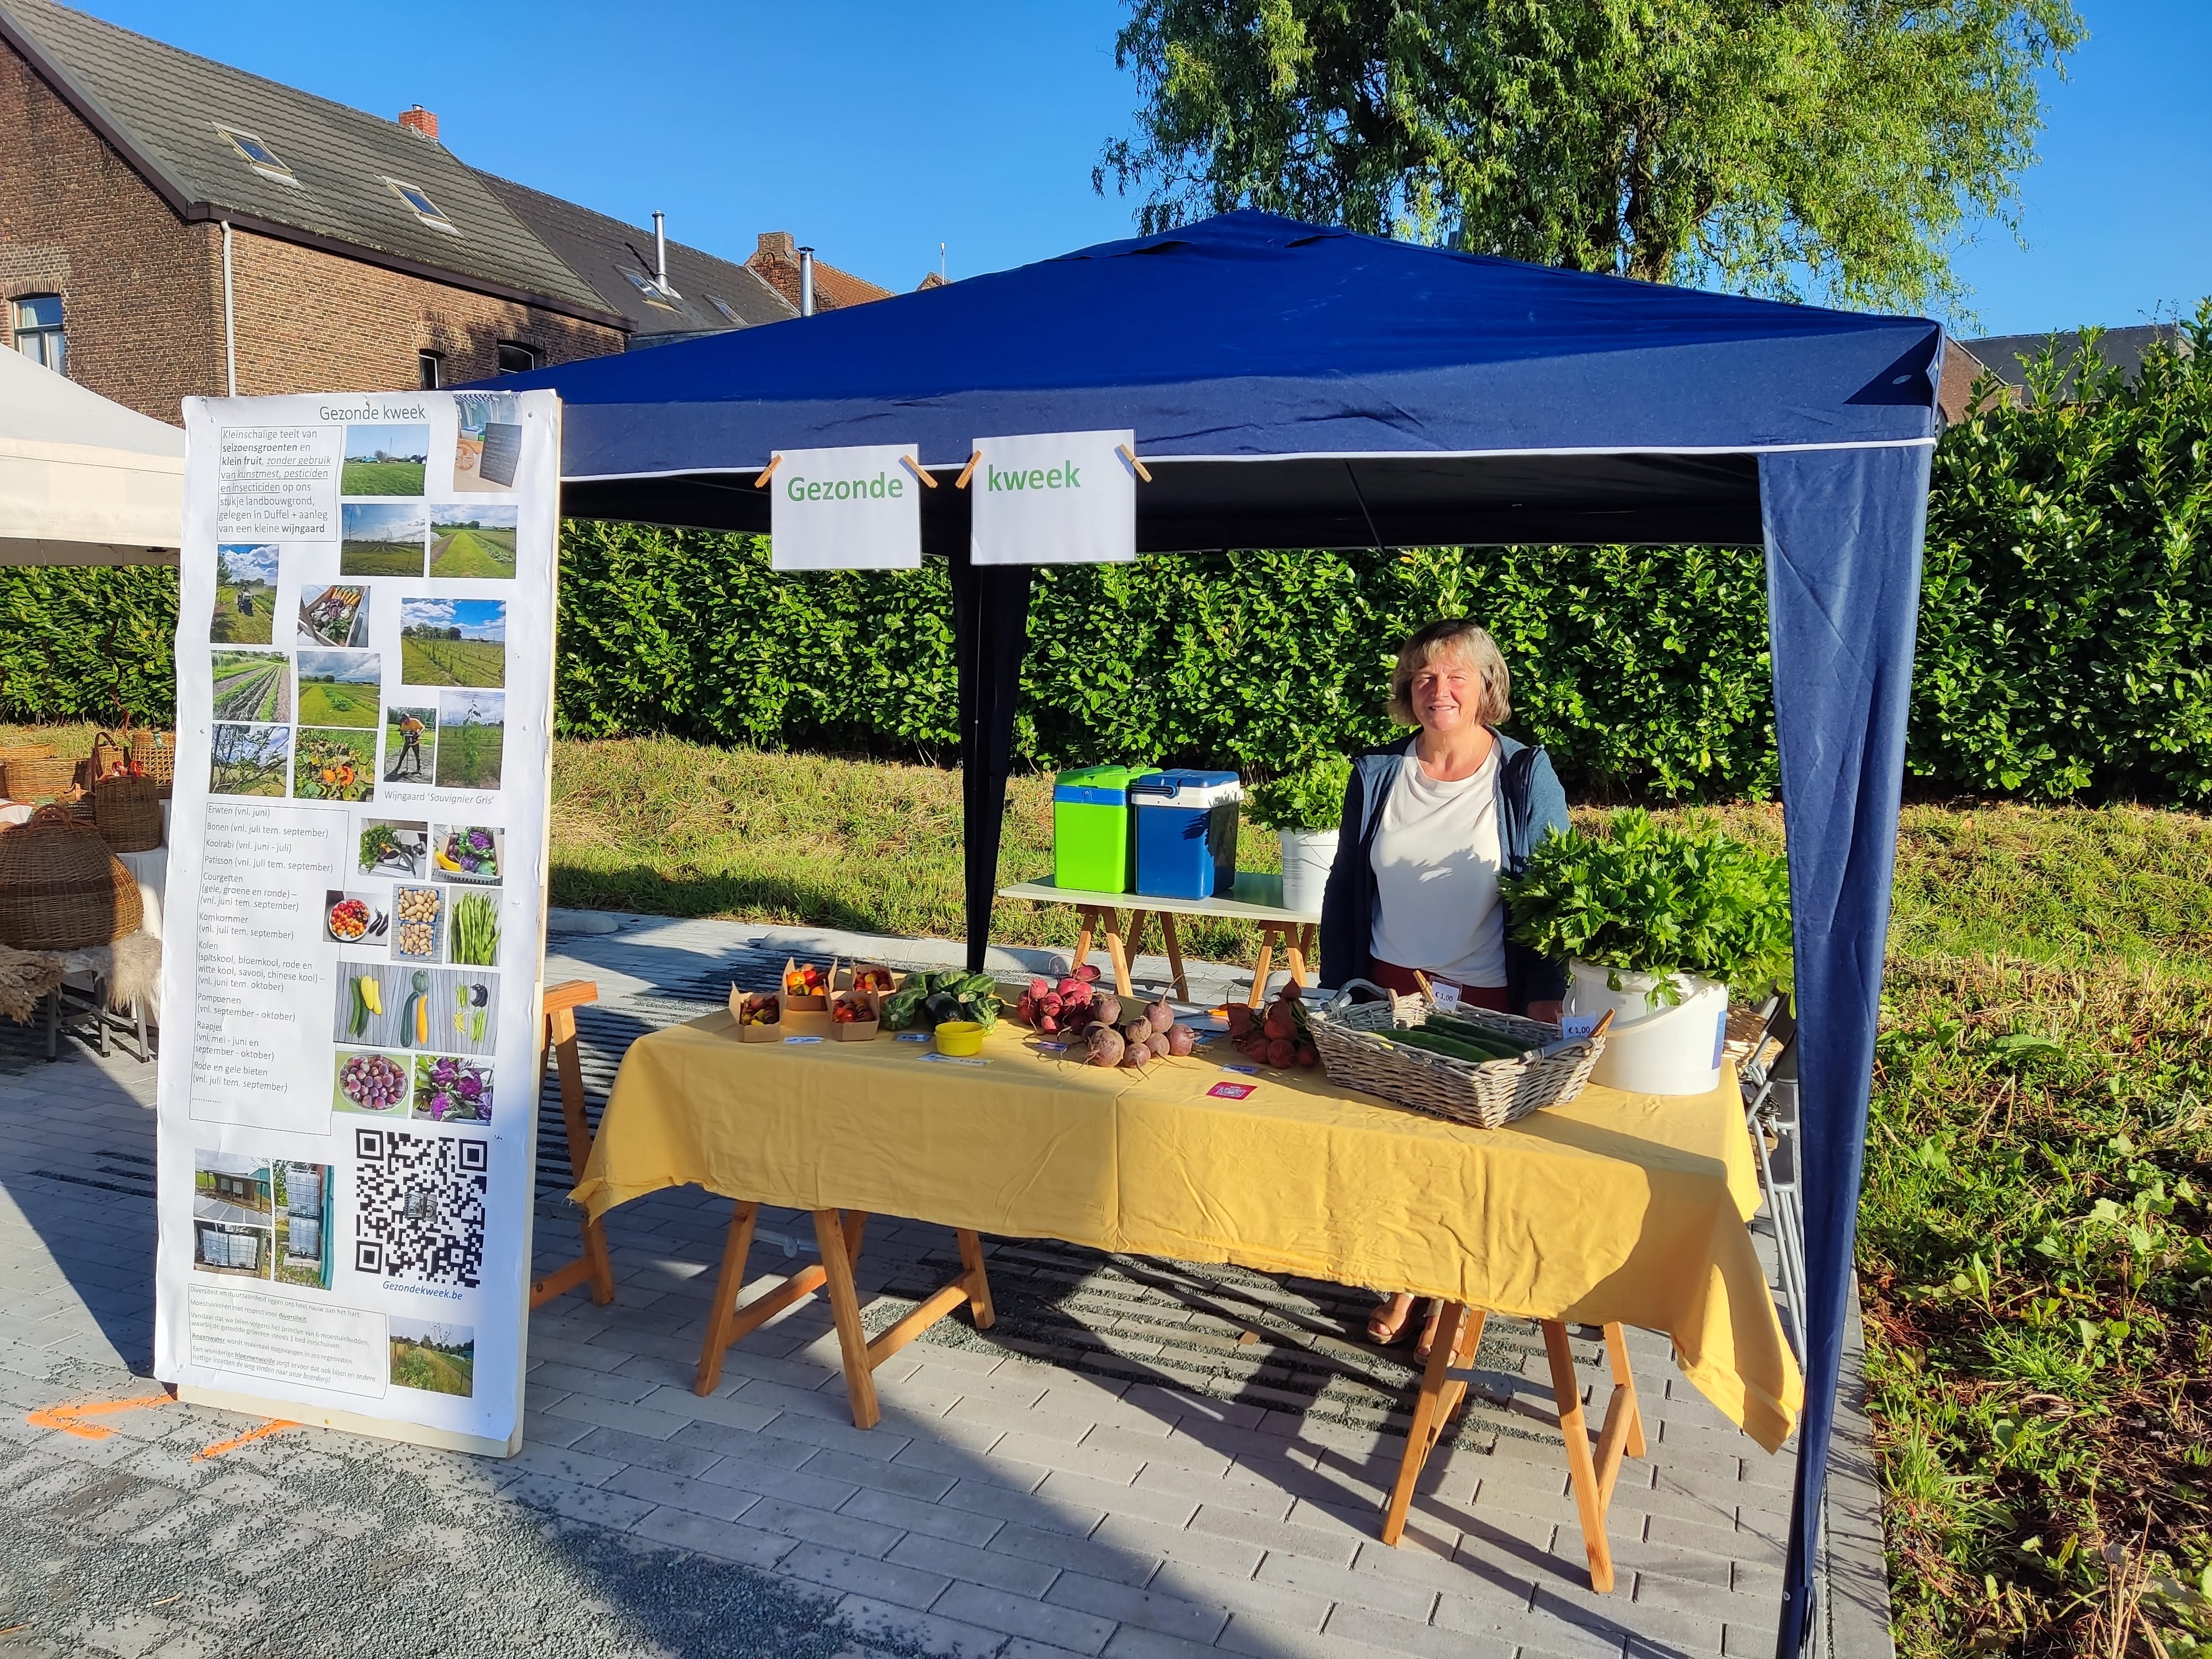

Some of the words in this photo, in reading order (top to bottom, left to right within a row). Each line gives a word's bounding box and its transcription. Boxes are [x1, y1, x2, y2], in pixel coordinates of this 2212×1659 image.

[320, 404, 379, 420] Gezonde
[383, 404, 425, 420] kweek
[223, 429, 277, 440] Kleinschalige
[280, 429, 300, 438] teelt
[222, 443, 297, 453] seizoensgroenten
[222, 456, 241, 465] klein
[244, 456, 264, 466] fruit,
[267, 456, 296, 465] zonder
[298, 456, 331, 466] gebruik
[237, 469, 281, 478] kunstmest,
[284, 469, 327, 479] pesticiden
[787, 472, 904, 502] Gezonde
[988, 460, 1080, 491] kweek
[232, 482, 280, 492] insecticiden
[283, 484, 293, 493] op
[220, 497, 243, 508] stukje
[246, 496, 315, 507] landbouwgrond,
[219, 510, 252, 521] gelegen
[264, 510, 289, 519] Duffel
[300, 510, 327, 520] aanleg
[255, 524, 279, 533] kleine
[281, 524, 325, 534] wijngaard
[384, 791, 425, 801] Wijngaard
[208, 806, 232, 815] Erwten
[252, 808, 270, 818] juni)
[207, 822, 228, 831] Bonen
[248, 825, 260, 834] juli
[283, 828, 328, 838] september)
[206, 839, 234, 848] Koolrabi
[254, 842, 269, 851] juni
[276, 843, 291, 853] juli)
[253, 859, 265, 868] juli
[288, 862, 333, 874] september)
[204, 873, 243, 883] Courgetten
[202, 884, 221, 894] (gele,
[264, 889, 289, 899] ronde)
[217, 897, 232, 906] juni
[253, 900, 299, 912] september)
[199, 912, 248, 924] Komkommer
[216, 925, 228, 935] juli
[251, 929, 294, 941] september)
[199, 941, 218, 950] Kolen
[238, 956, 280, 967] bloemkool,
[198, 964, 215, 973] witte
[218, 966, 236, 976] kool,
[239, 969, 265, 979] savooi,
[268, 971, 296, 980] chinese
[299, 973, 317, 983] kool)
[213, 978, 228, 987] juni
[251, 982, 284, 993] oktober)
[1441, 993, 1453, 1002] 1,00
[214, 1006, 254, 1017] september
[262, 1011, 295, 1022] oktober)
[197, 1021, 222, 1032] Raapjes
[232, 1036, 247, 1046] juni
[196, 1046, 234, 1056] september
[241, 1050, 274, 1061] oktober)
[194, 1061, 211, 1071] Rode
[225, 1065, 241, 1074] gele
[244, 1065, 268, 1076] bieten
[210, 1076, 221, 1085] juli
[243, 1080, 288, 1093] september)
[383, 1281, 462, 1300] Gezondekweek.be
